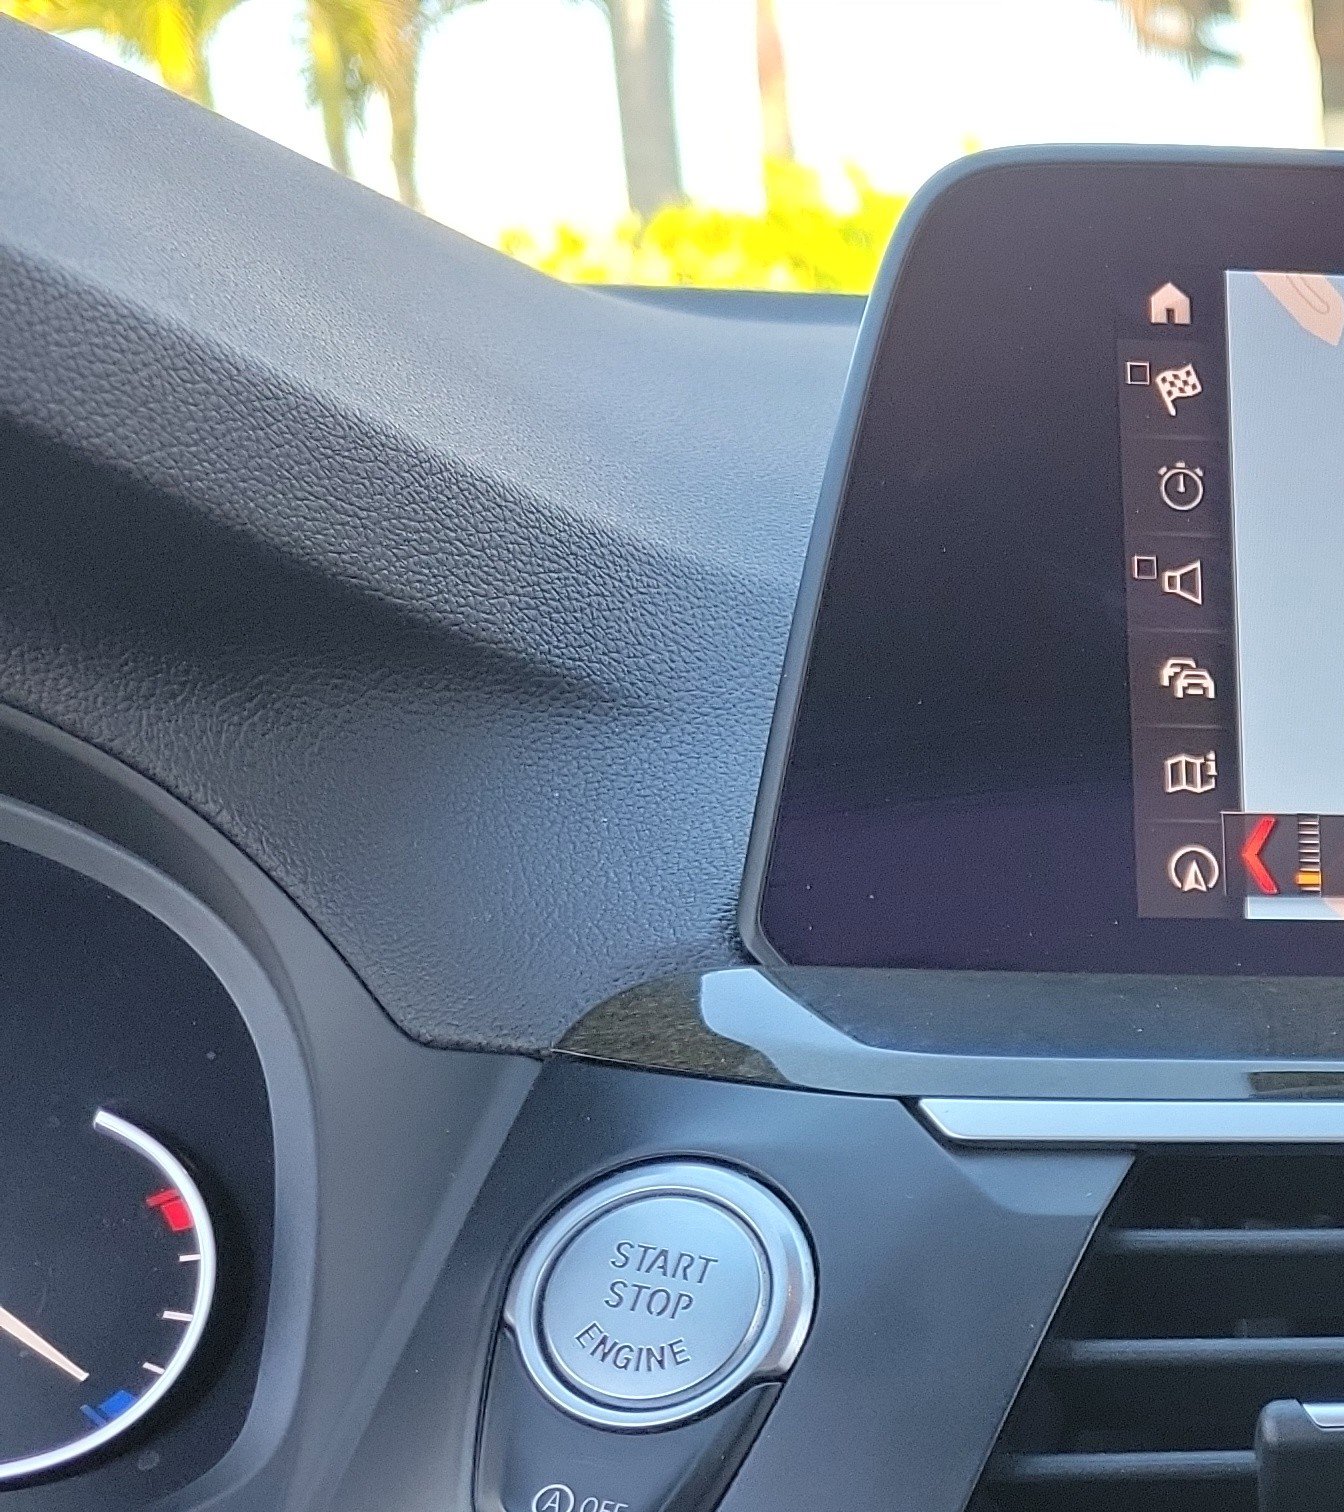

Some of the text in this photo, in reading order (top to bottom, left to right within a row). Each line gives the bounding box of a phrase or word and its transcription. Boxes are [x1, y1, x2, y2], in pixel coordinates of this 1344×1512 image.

[609, 1241, 718, 1284] START
[603, 1281, 694, 1321] STOP
[574, 1321, 692, 1372] ENGINE
